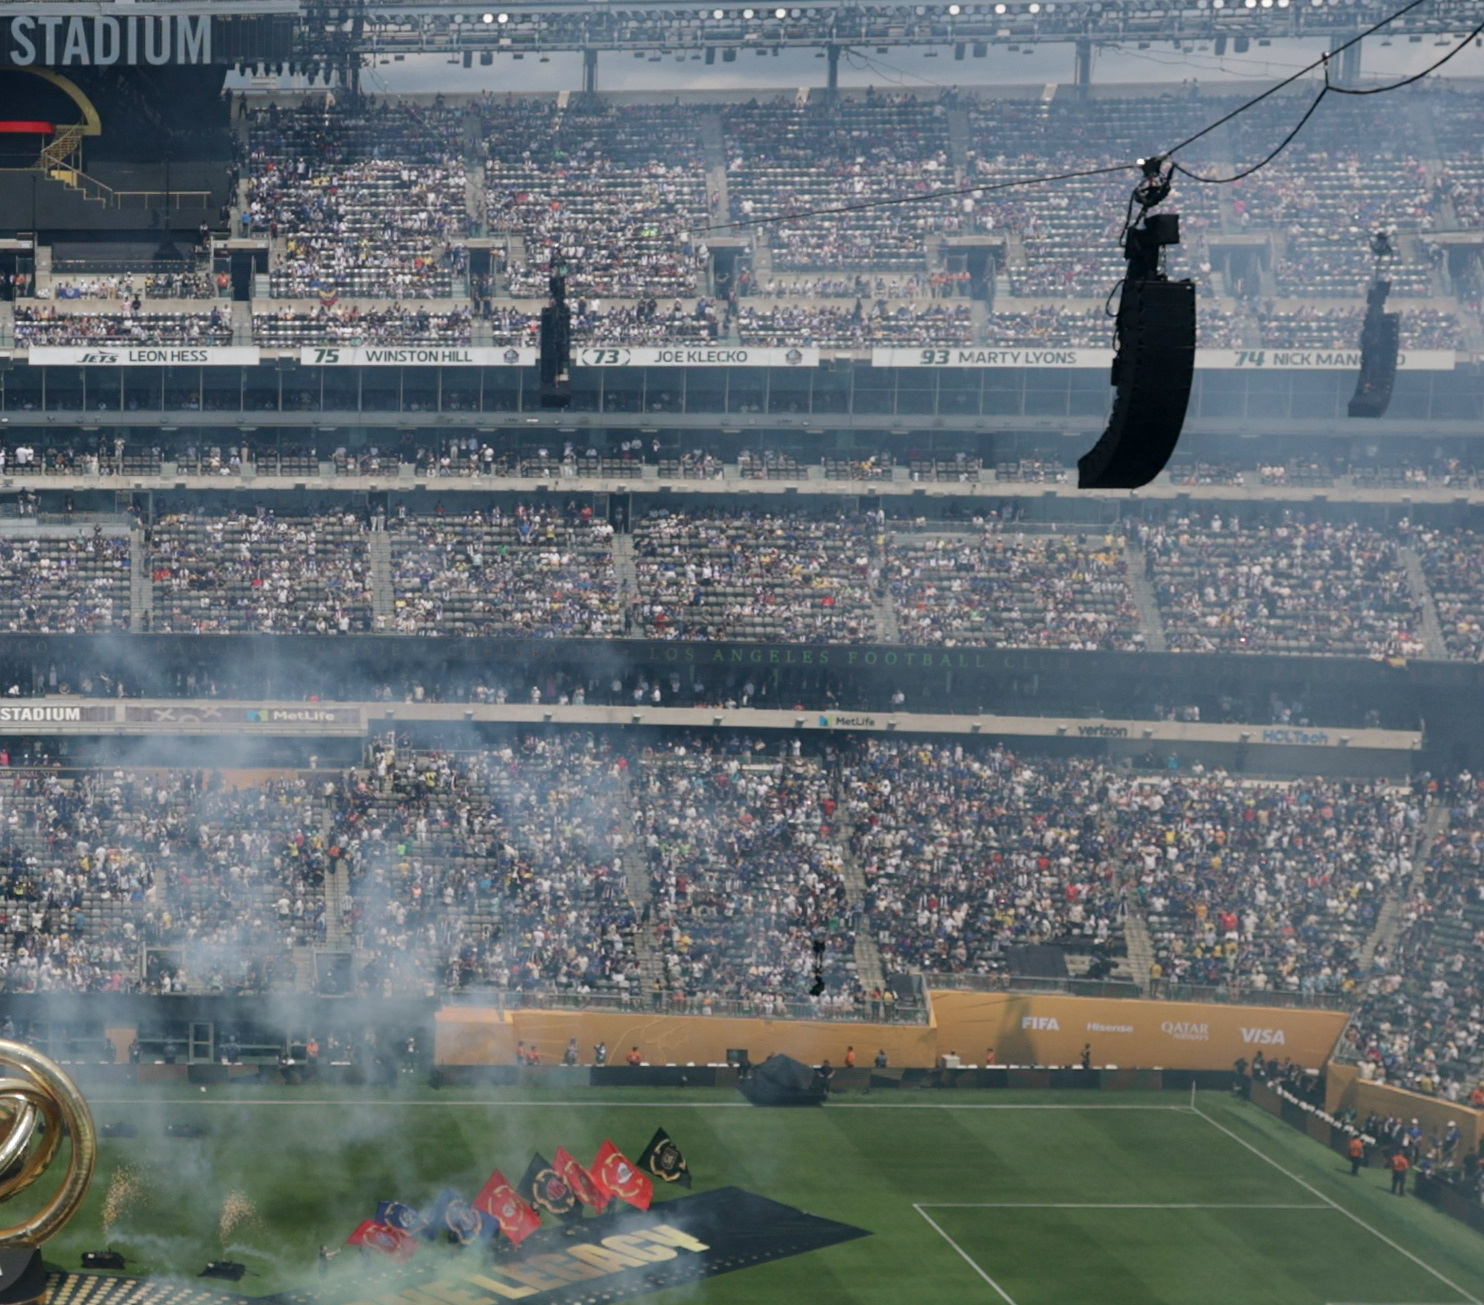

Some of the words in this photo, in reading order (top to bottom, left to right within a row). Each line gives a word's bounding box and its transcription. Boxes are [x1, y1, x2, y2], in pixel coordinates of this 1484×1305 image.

[10, 15, 212, 65] STADIUM
[77, 351, 120, 363] JETS
[129, 351, 166, 362] LEON
[170, 351, 208, 362] HESS
[314, 349, 340, 363] 75
[365, 351, 438, 362] WINSTON
[442, 351, 473, 362] HILL
[594, 350, 619, 363] 73
[654, 351, 682, 363] JOE
[686, 351, 748, 363] KLECKO
[920, 350, 950, 364] 93
[958, 352, 1021, 364] MARTY
[1024, 352, 1076, 364] LYONS
[1235, 352, 1265, 366] 74
[1273, 353, 1311, 365] NICK
[648, 648, 695, 661] LOS
[712, 649, 830, 664] ANGELES
[847, 651, 985, 668] FOOTBALL
[0, 707, 80, 721] STADIUM
[273, 710, 335, 722] MetLife
[836, 716, 875, 728] MetLife
[1078, 724, 1127, 738] verizon
[1263, 728, 1329, 744] HCLTech
[1021, 1016, 1060, 1031] FIFA
[1087, 1022, 1134, 1034] Hisense
[1161, 1021, 1209, 1035] QATAR
[1240, 1028, 1286, 1045] VISA
[463, 1224, 711, 1300] LEGACY
